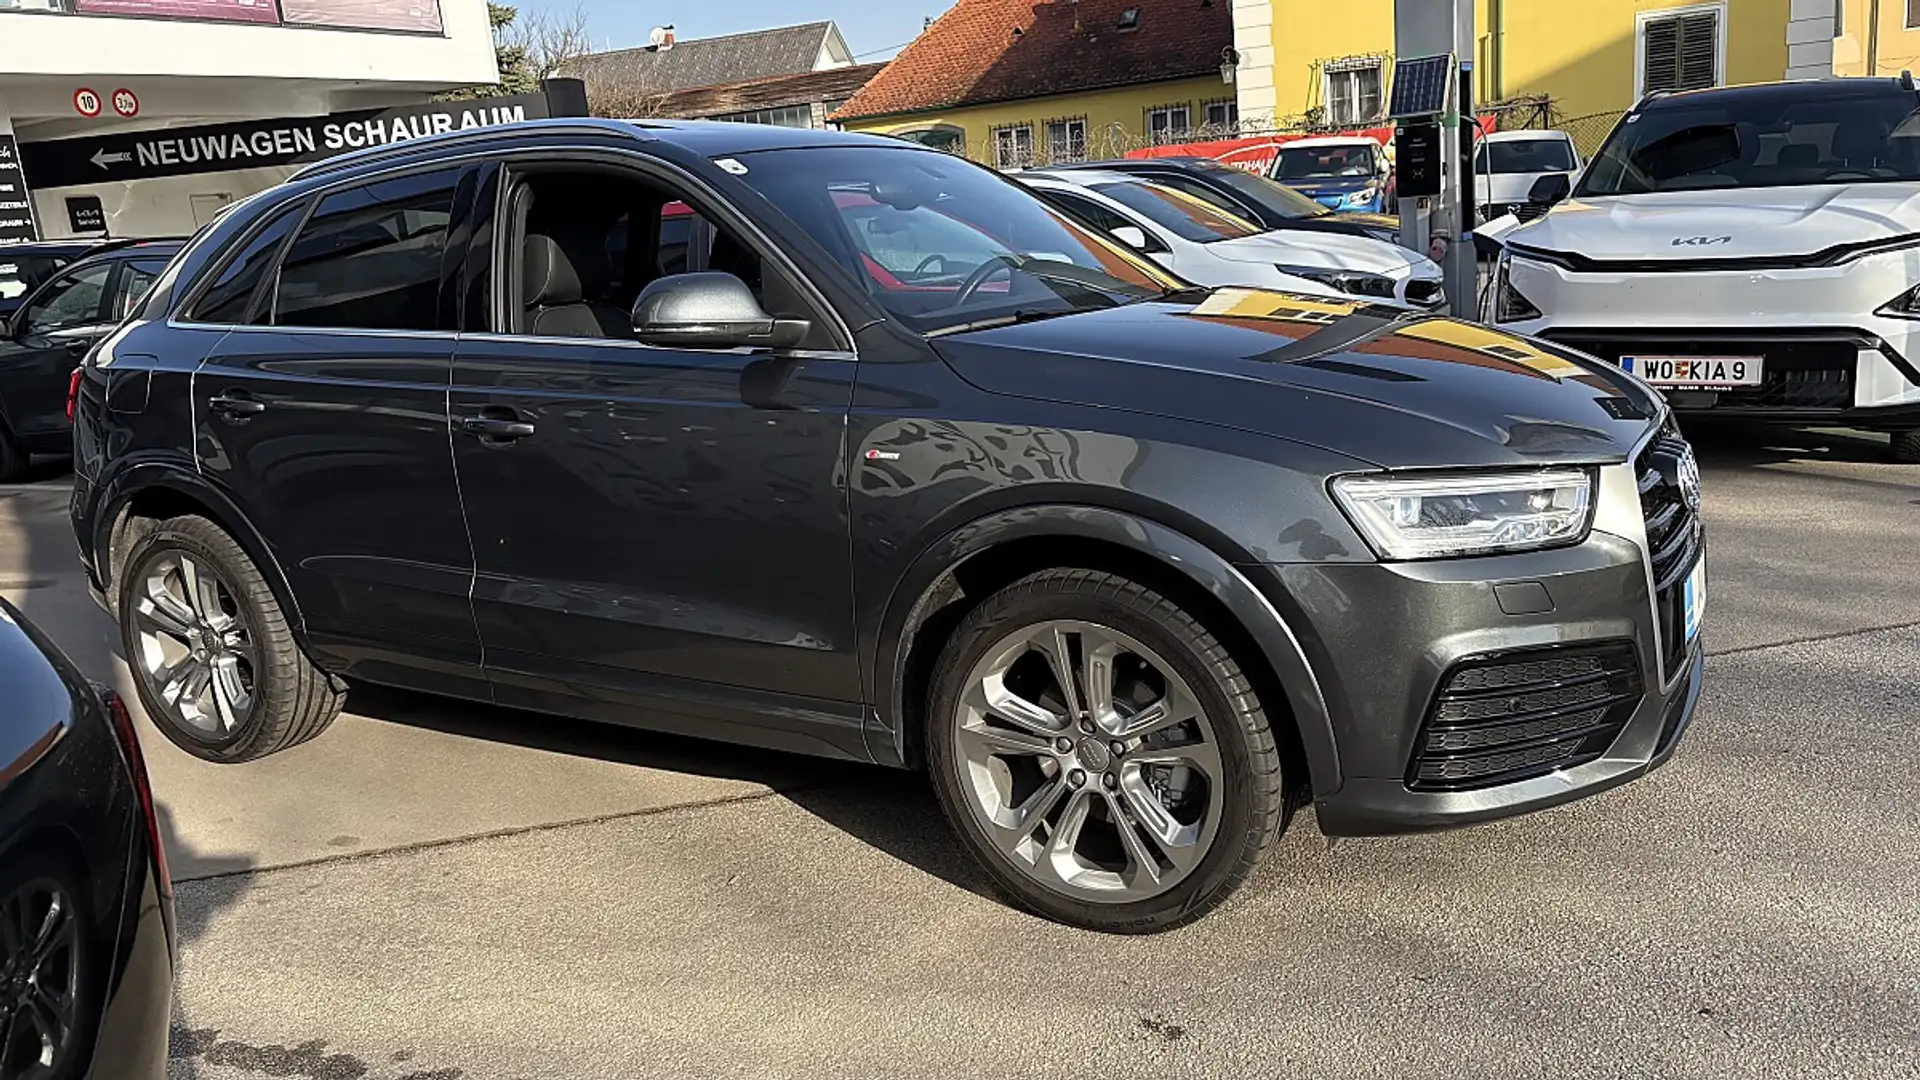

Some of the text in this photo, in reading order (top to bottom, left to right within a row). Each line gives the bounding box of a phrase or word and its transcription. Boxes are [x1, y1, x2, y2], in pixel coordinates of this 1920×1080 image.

[81, 96, 94, 110] 10
[136, 106, 525, 167] NEUWAGEN SCHAURAUM
[1671, 236, 1732, 246] KIA
[1644, 360, 1673, 379] WO
